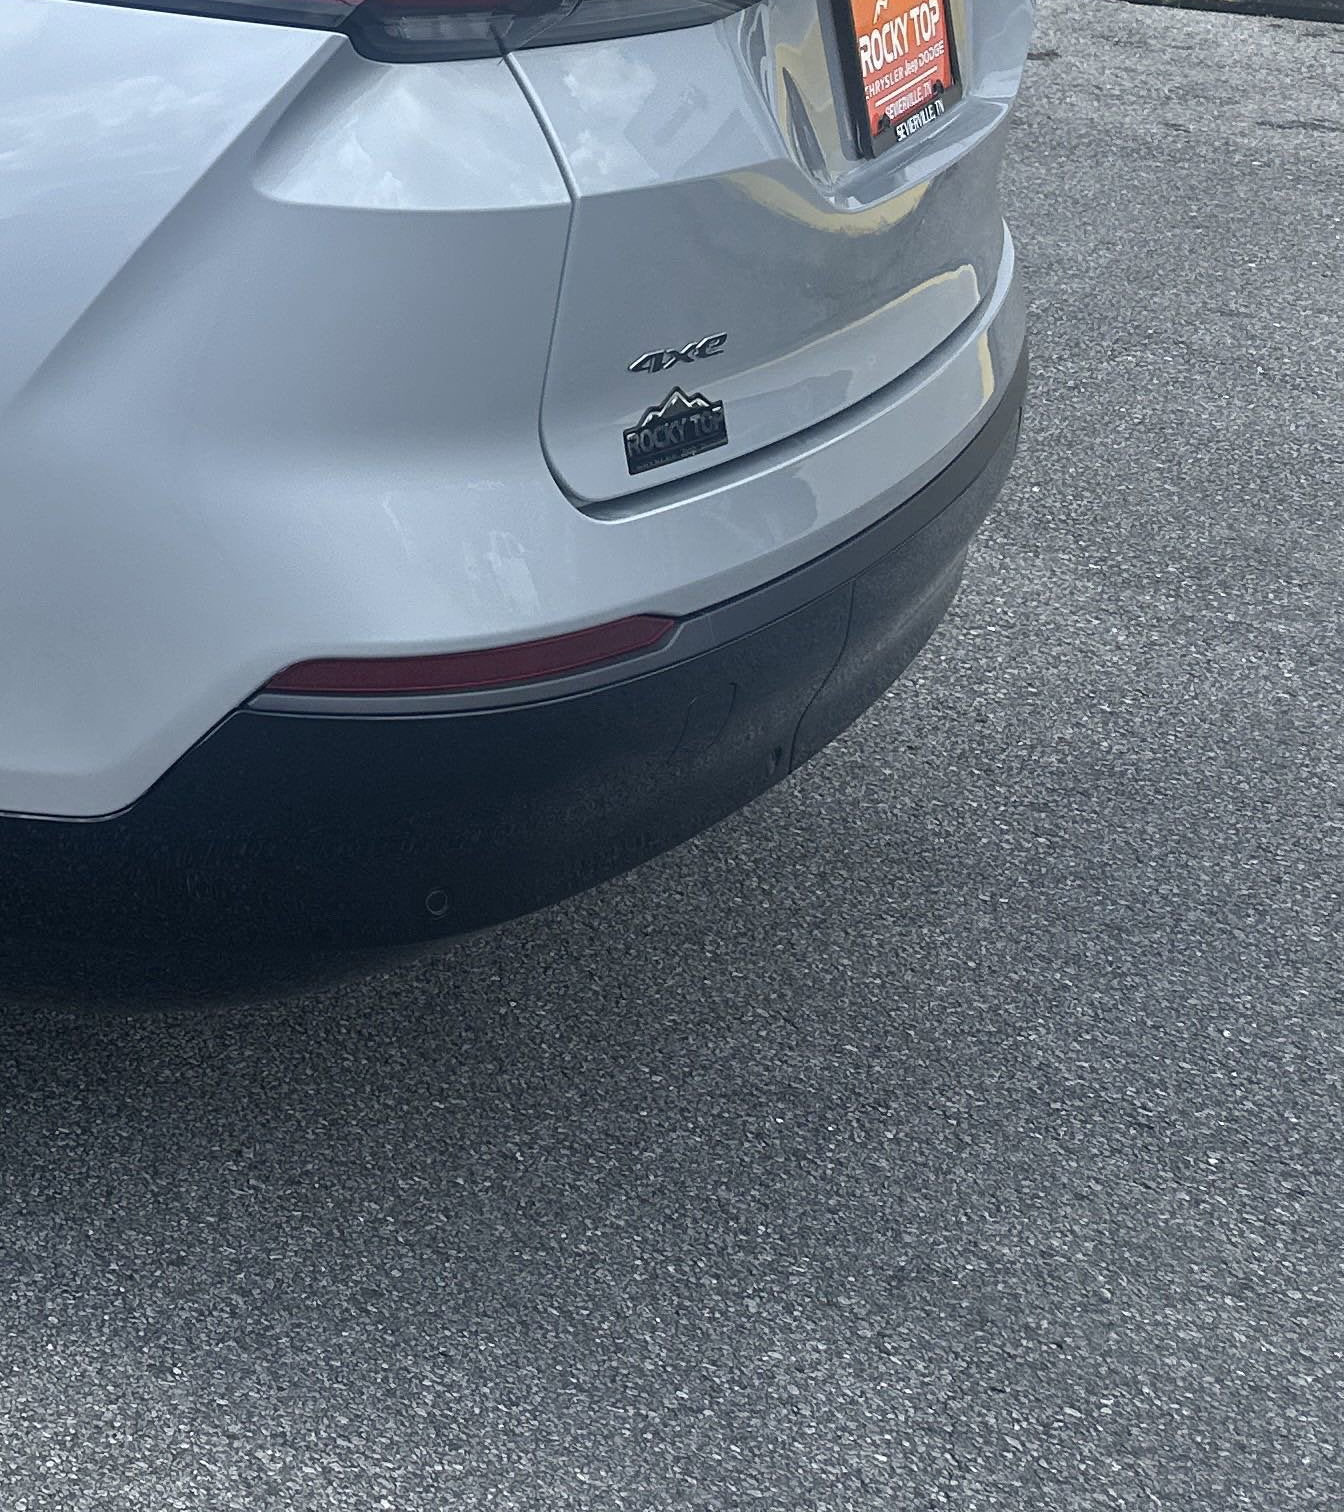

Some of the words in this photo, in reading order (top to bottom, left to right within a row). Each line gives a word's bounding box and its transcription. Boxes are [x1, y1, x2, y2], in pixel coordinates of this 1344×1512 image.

[858, 12, 909, 78] ROCKY
[864, 66, 904, 100] CHRYSLER
[918, 39, 945, 67] DODGE
